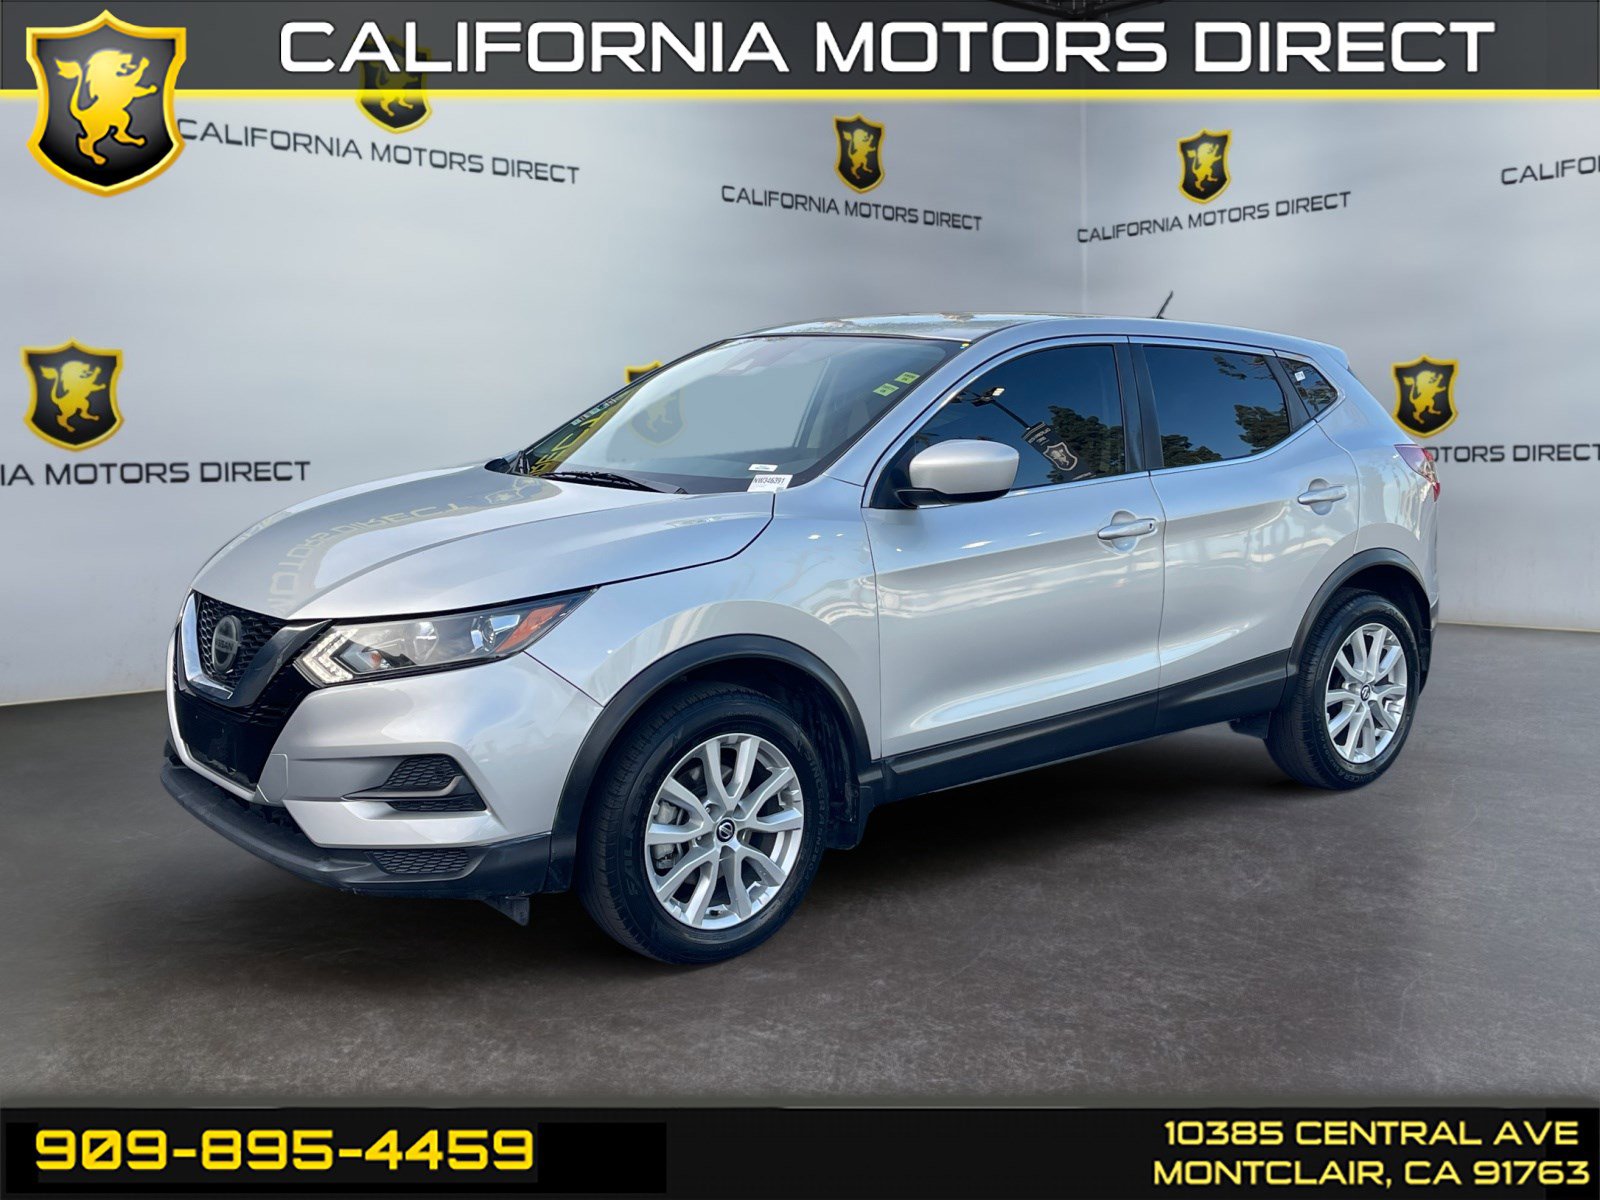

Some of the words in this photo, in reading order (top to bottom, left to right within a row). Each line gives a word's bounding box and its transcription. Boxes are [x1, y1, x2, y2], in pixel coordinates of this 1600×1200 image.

[177, 117, 362, 160] CALIFORNIA
[371, 142, 484, 174] MOTORS
[492, 157, 580, 185] DIRECT
[721, 184, 839, 215] CALIFORNIA
[844, 200, 919, 223] MOTORS
[924, 208, 982, 231] DIRECT
[1077, 215, 1183, 243] CALIFORNIA
[1188, 203, 1270, 230] MOTORS
[1275, 190, 1352, 217] DIRECT
[45, 462, 190, 485] MOTORS
[200, 460, 311, 483] DIRECT
[1424, 445, 1505, 463] OTORS
[1512, 443, 1600, 463] DIRECT
